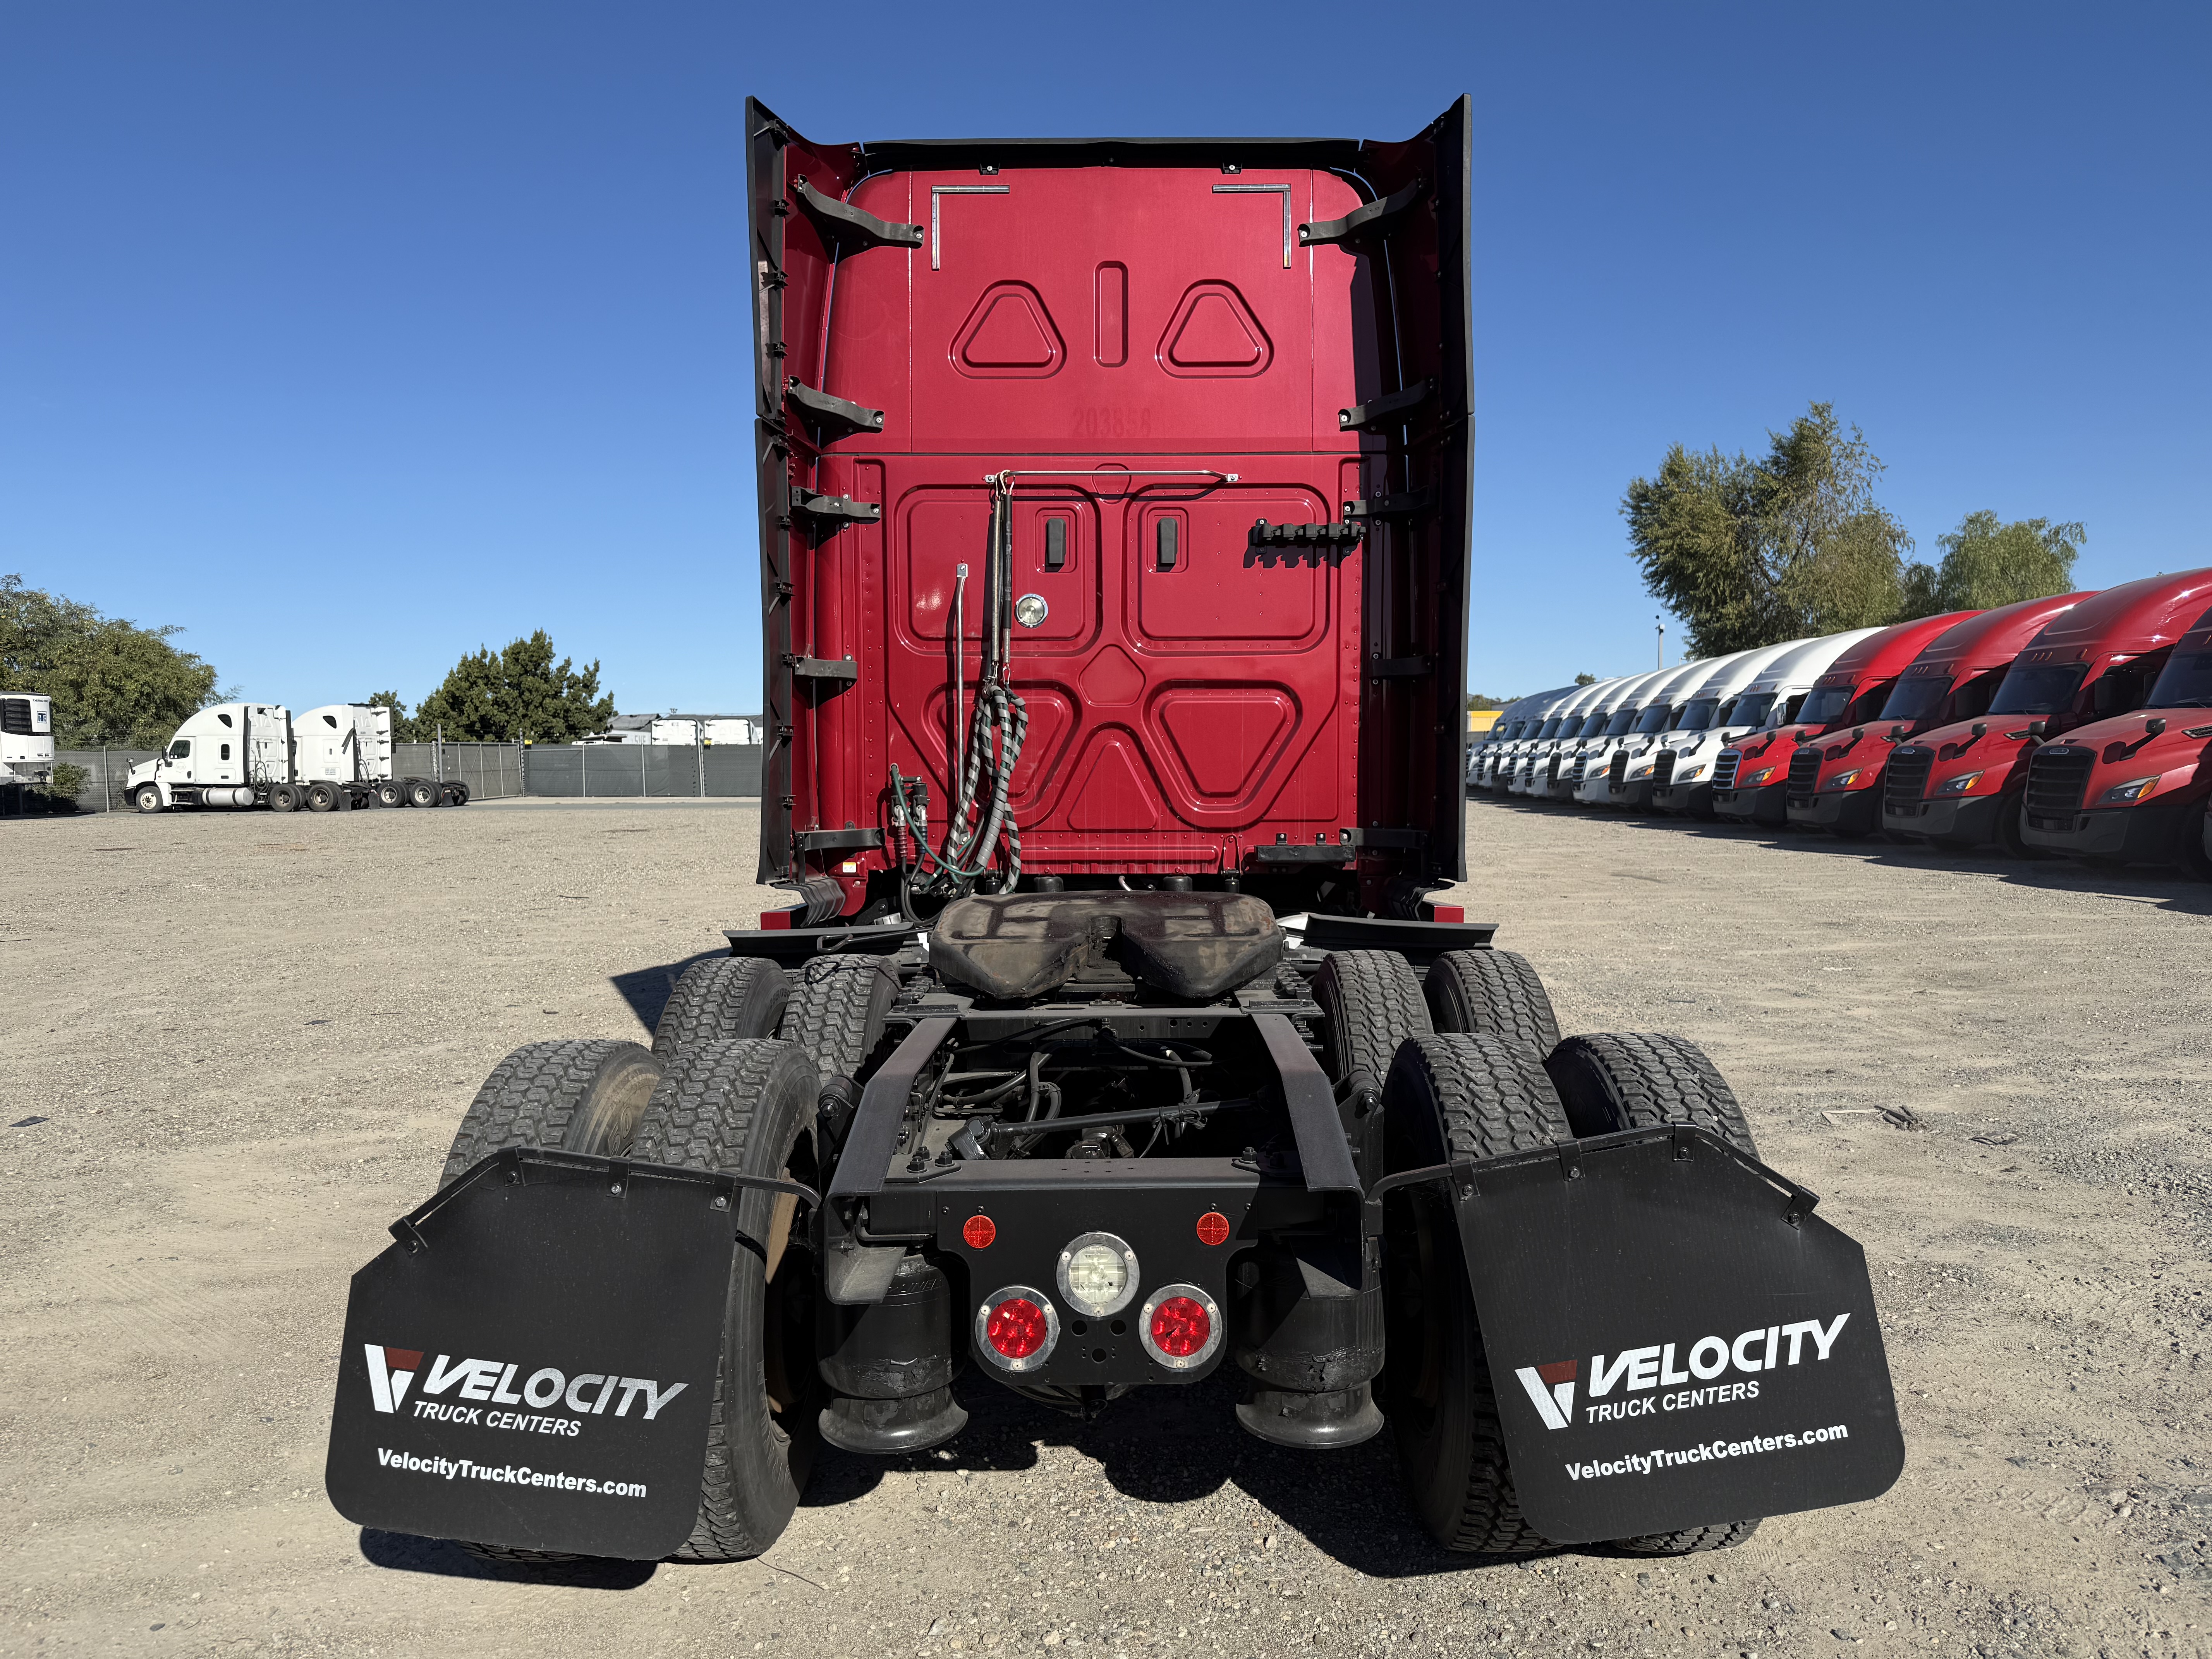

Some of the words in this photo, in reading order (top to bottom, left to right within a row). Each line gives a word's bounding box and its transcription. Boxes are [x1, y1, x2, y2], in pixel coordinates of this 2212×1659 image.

[1589, 1312, 1851, 1398] VELOCITY
[423, 1354, 689, 1420] VELOCITY
[1586, 1396, 1656, 1424] TRUCK
[1662, 1381, 1759, 1411] CENTERS
[414, 1400, 483, 1425] TRUCK
[486, 1411, 581, 1437] CENTERS
[378, 1448, 647, 1498] VelocityTruckCenters.com
[1565, 1424, 1848, 1480] VelocityTruckCenters.com
